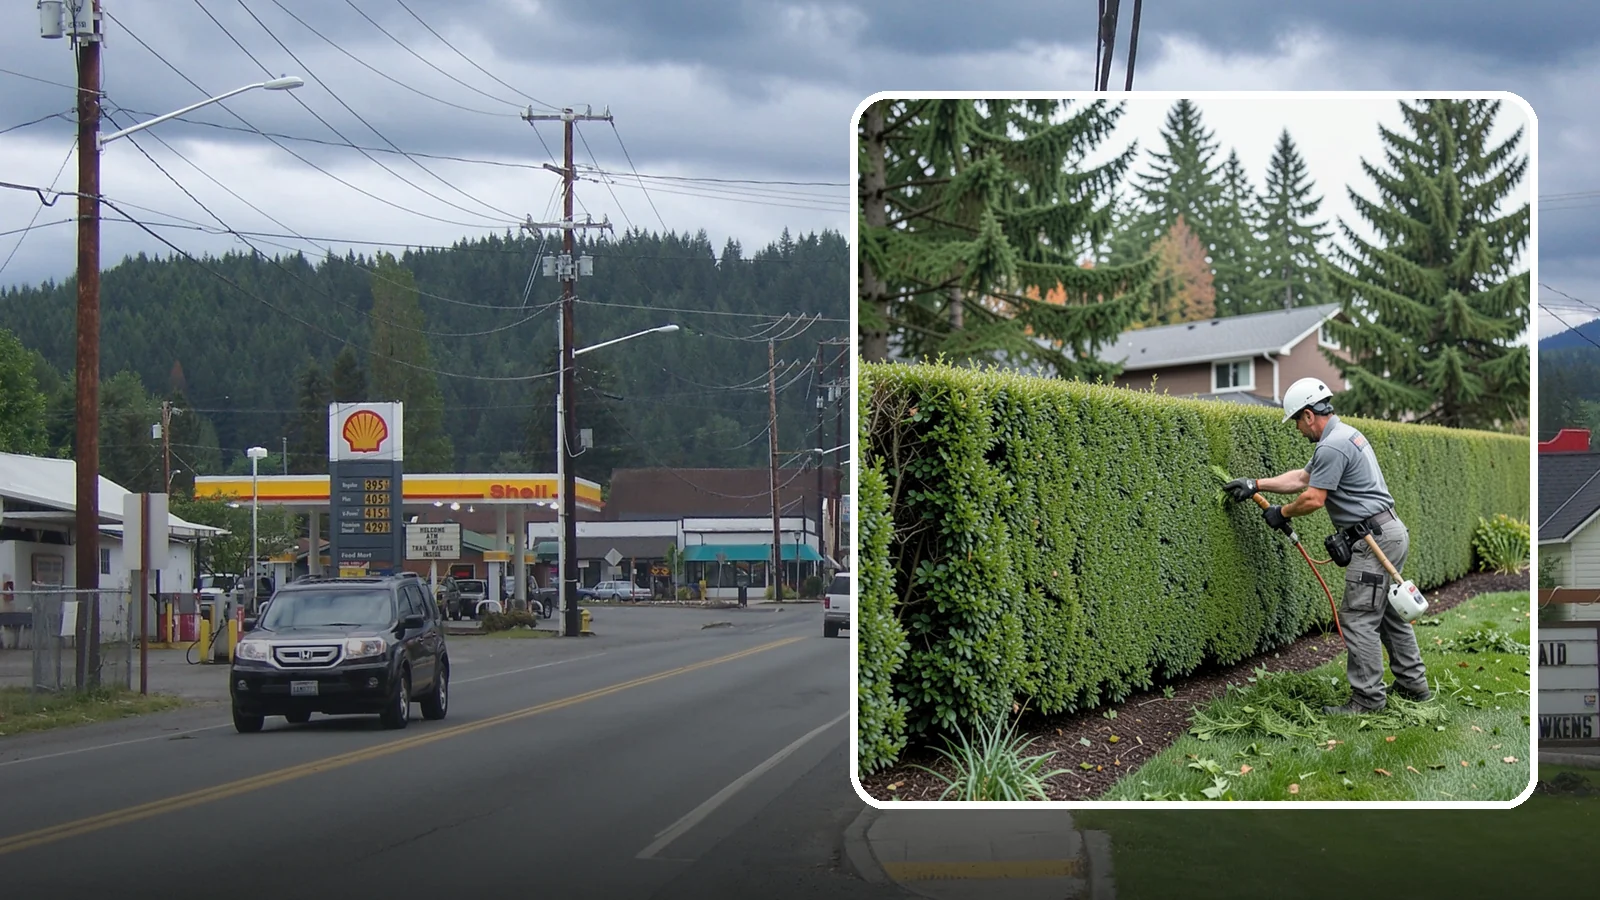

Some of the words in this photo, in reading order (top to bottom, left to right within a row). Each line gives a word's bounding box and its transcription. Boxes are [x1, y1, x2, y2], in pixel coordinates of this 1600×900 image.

[366, 480, 383, 490] 395
[490, 484, 547, 499] Shell
[366, 494, 383, 504] 405
[366, 508, 383, 518] 415
[366, 522, 383, 532] 429
[1538, 643, 1567, 665] AID
